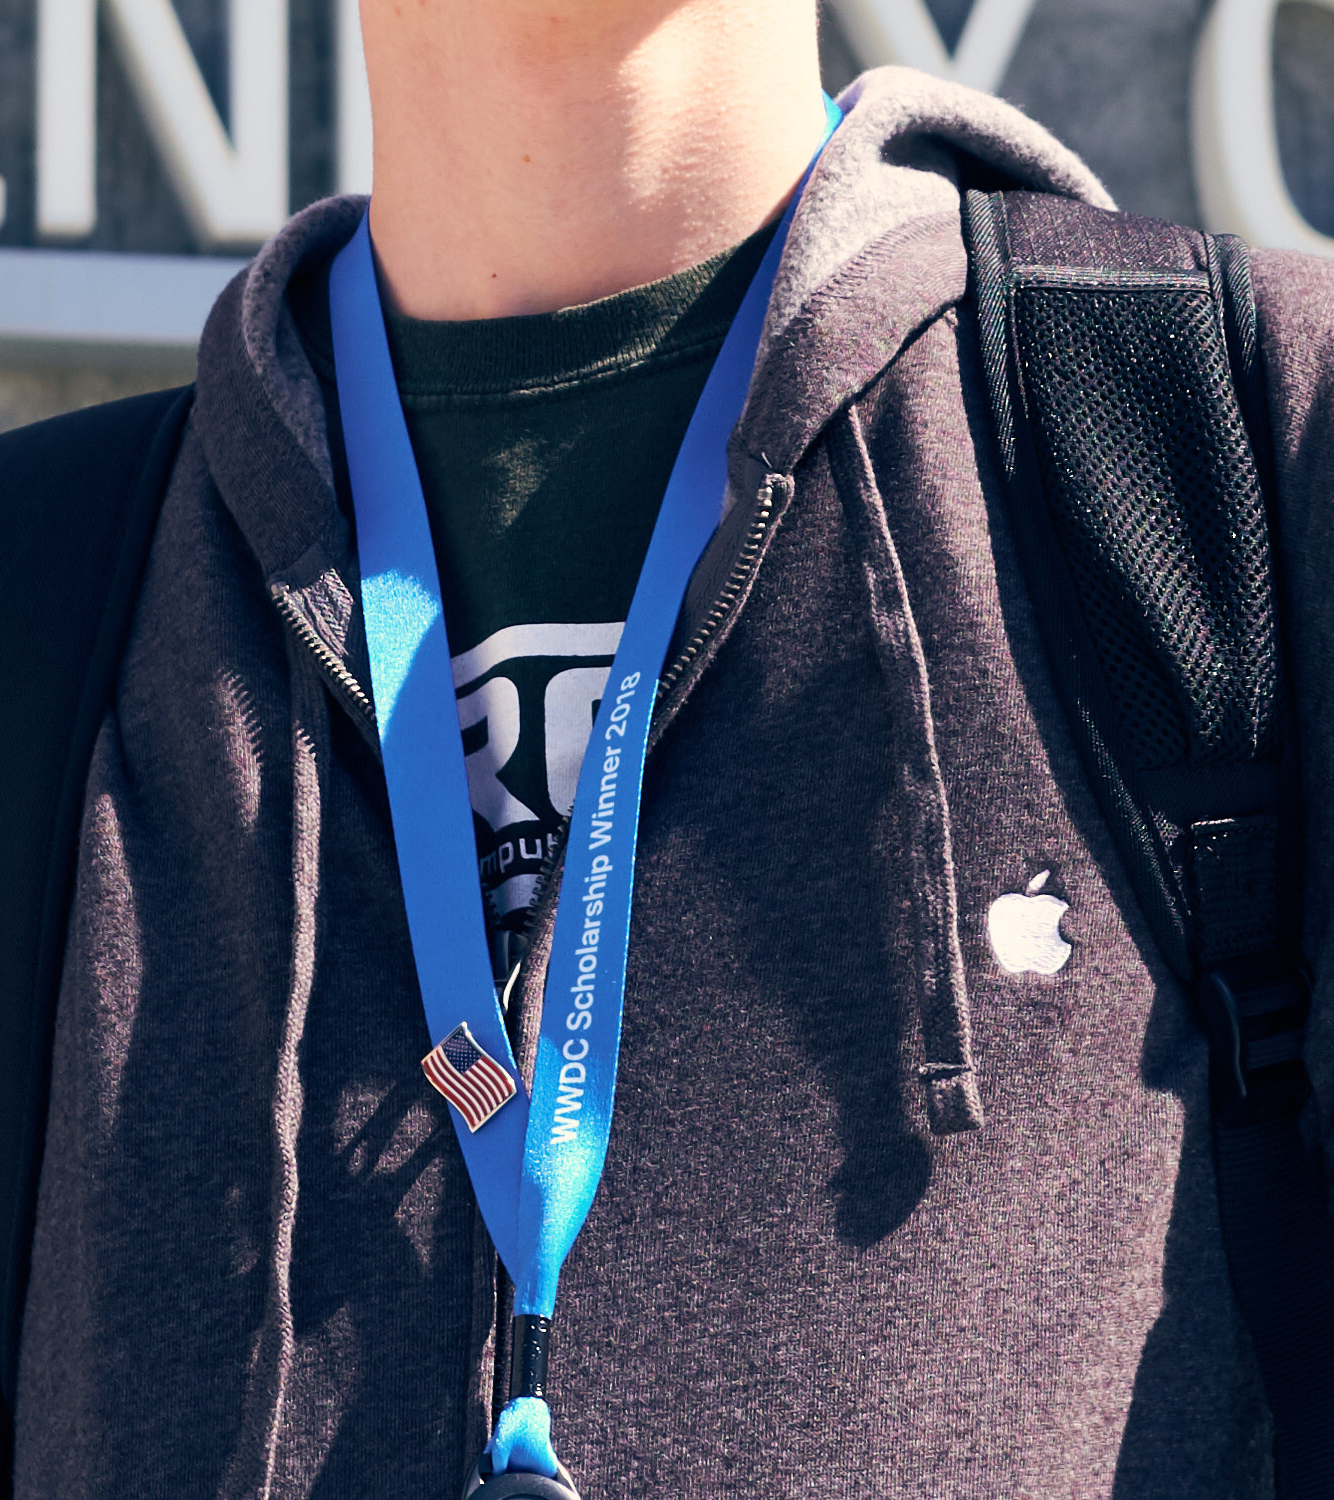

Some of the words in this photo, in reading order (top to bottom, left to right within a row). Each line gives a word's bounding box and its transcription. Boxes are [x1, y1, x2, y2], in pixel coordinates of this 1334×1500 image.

[605, 671, 641, 741] 2018
[589, 746, 622, 850] Winner
[566, 854, 613, 1031] Scholarship
[550, 1038, 589, 1145] WWDC
